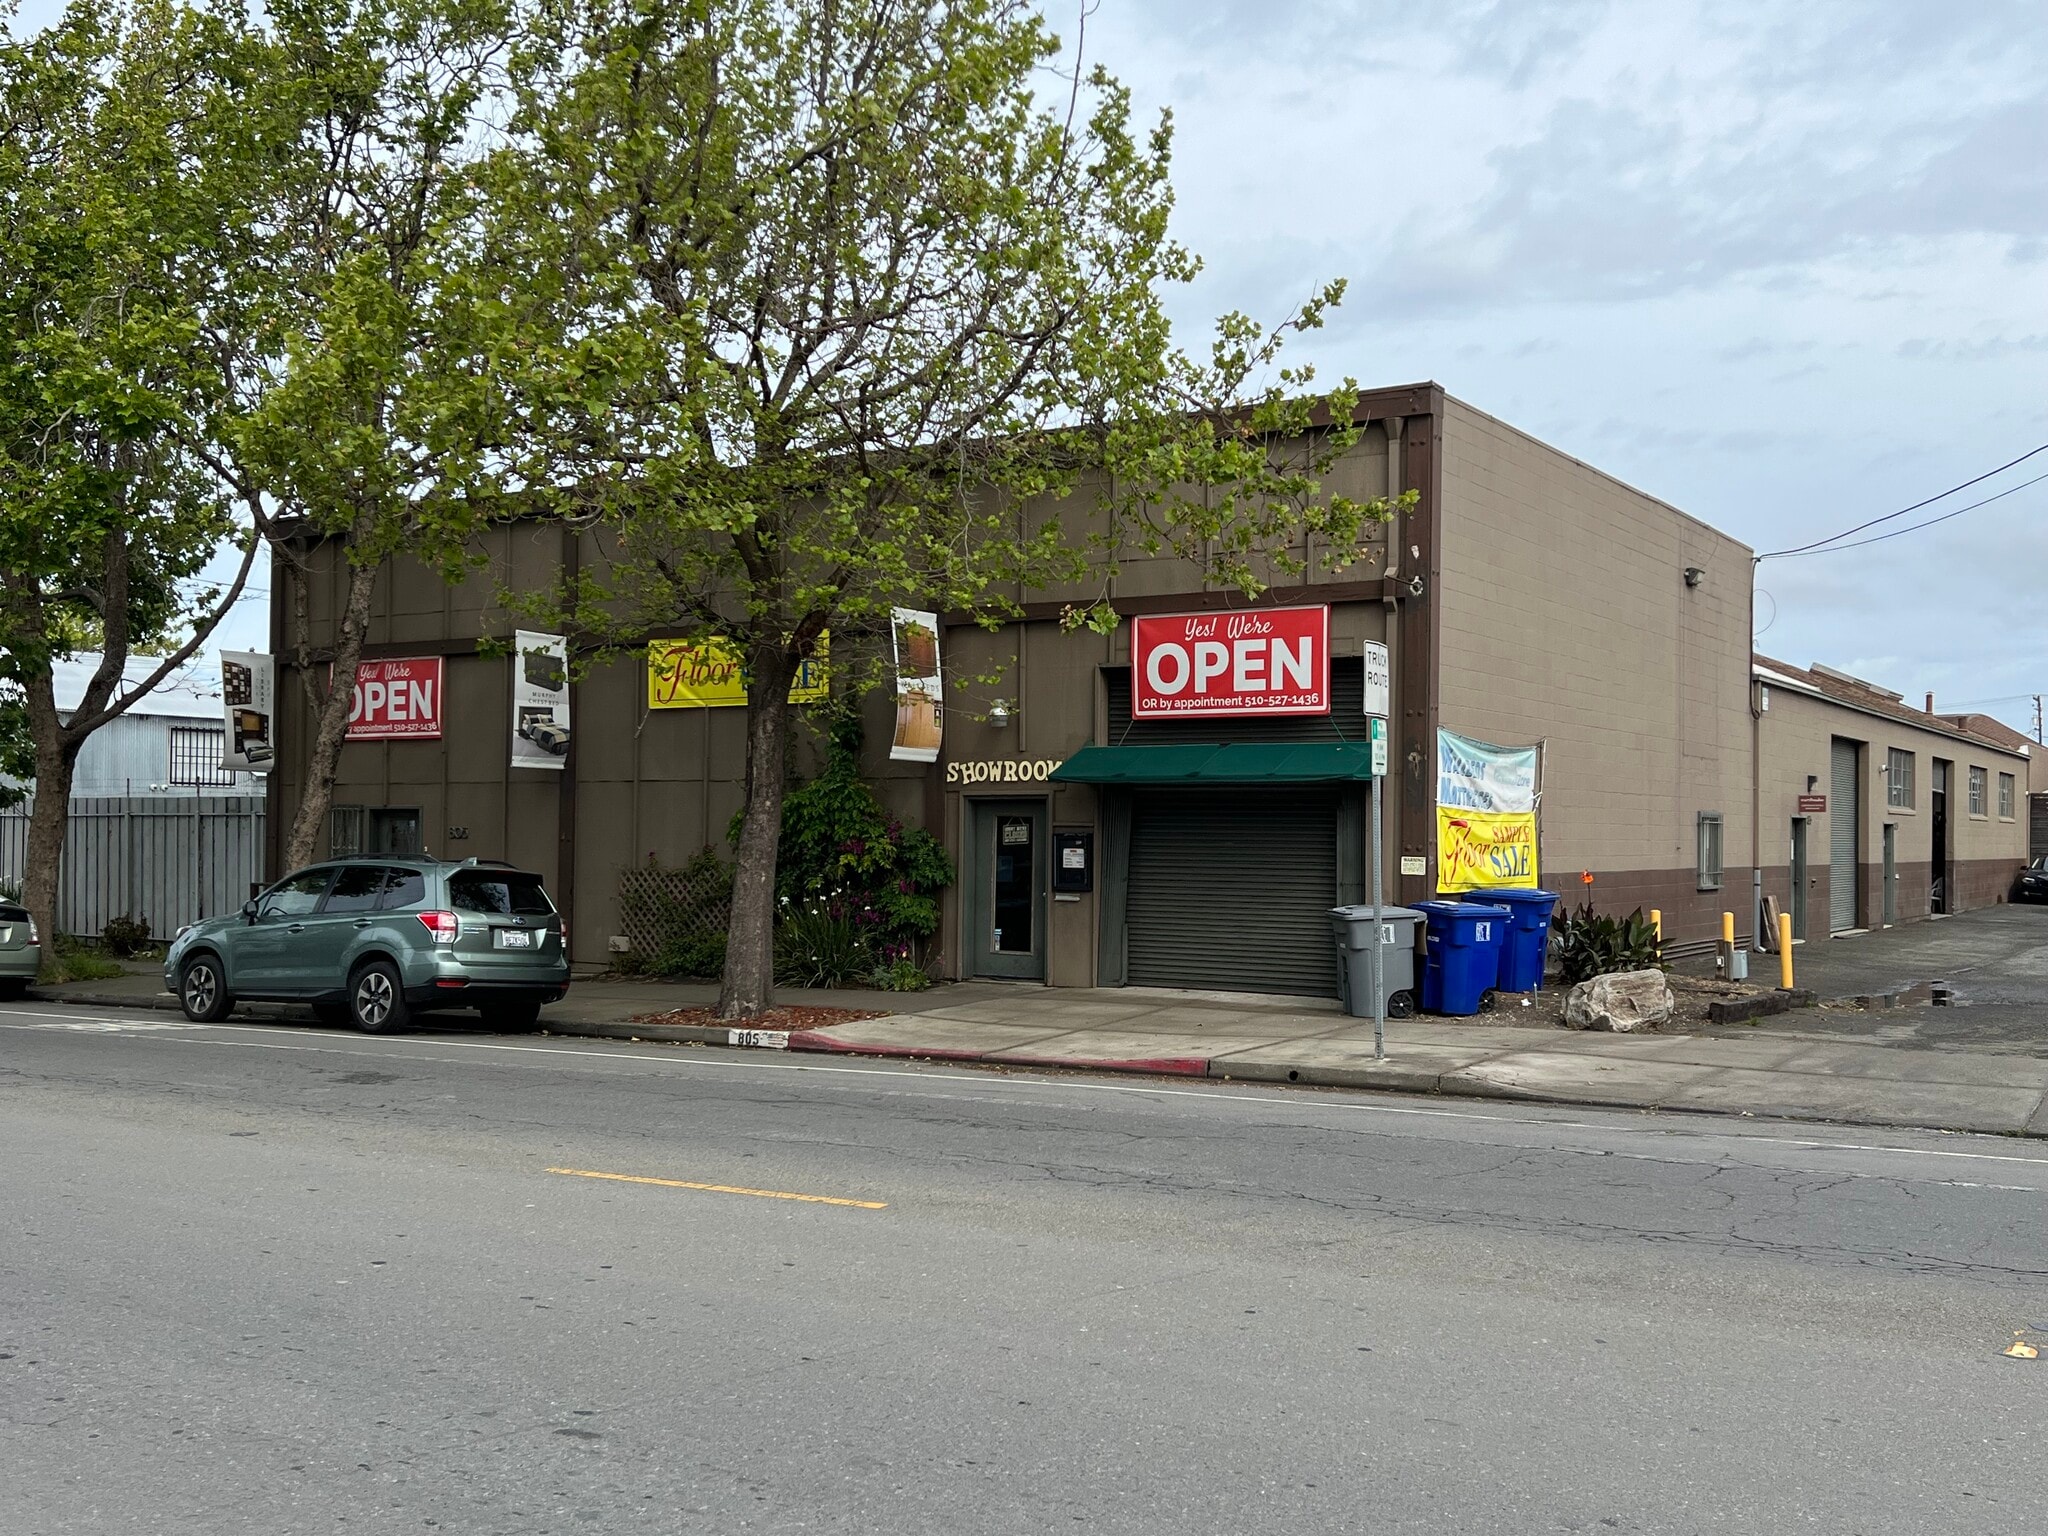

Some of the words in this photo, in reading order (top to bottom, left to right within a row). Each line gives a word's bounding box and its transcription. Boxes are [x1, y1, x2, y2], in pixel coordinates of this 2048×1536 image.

[1185, 617, 1217, 641] Yes!
[1227, 614, 1273, 639] We're
[360, 665, 379, 682] Yes!
[384, 663, 412, 680] We're
[1146, 636, 1313, 695] OPEN
[1367, 671, 1389, 688] ROUTE
[1142, 698, 1158, 709] OR
[1159, 697, 1173, 711] by
[1174, 695, 1243, 710] appointment
[1244, 693, 1319, 708] 510-527-1436
[353, 723, 393, 734] appointment
[1492, 826, 1530, 844] SAMPLE
[1444, 820, 1490, 887] Floor
[1490, 845, 1531, 878] SALE
[738, 1032, 759, 1045] 805
